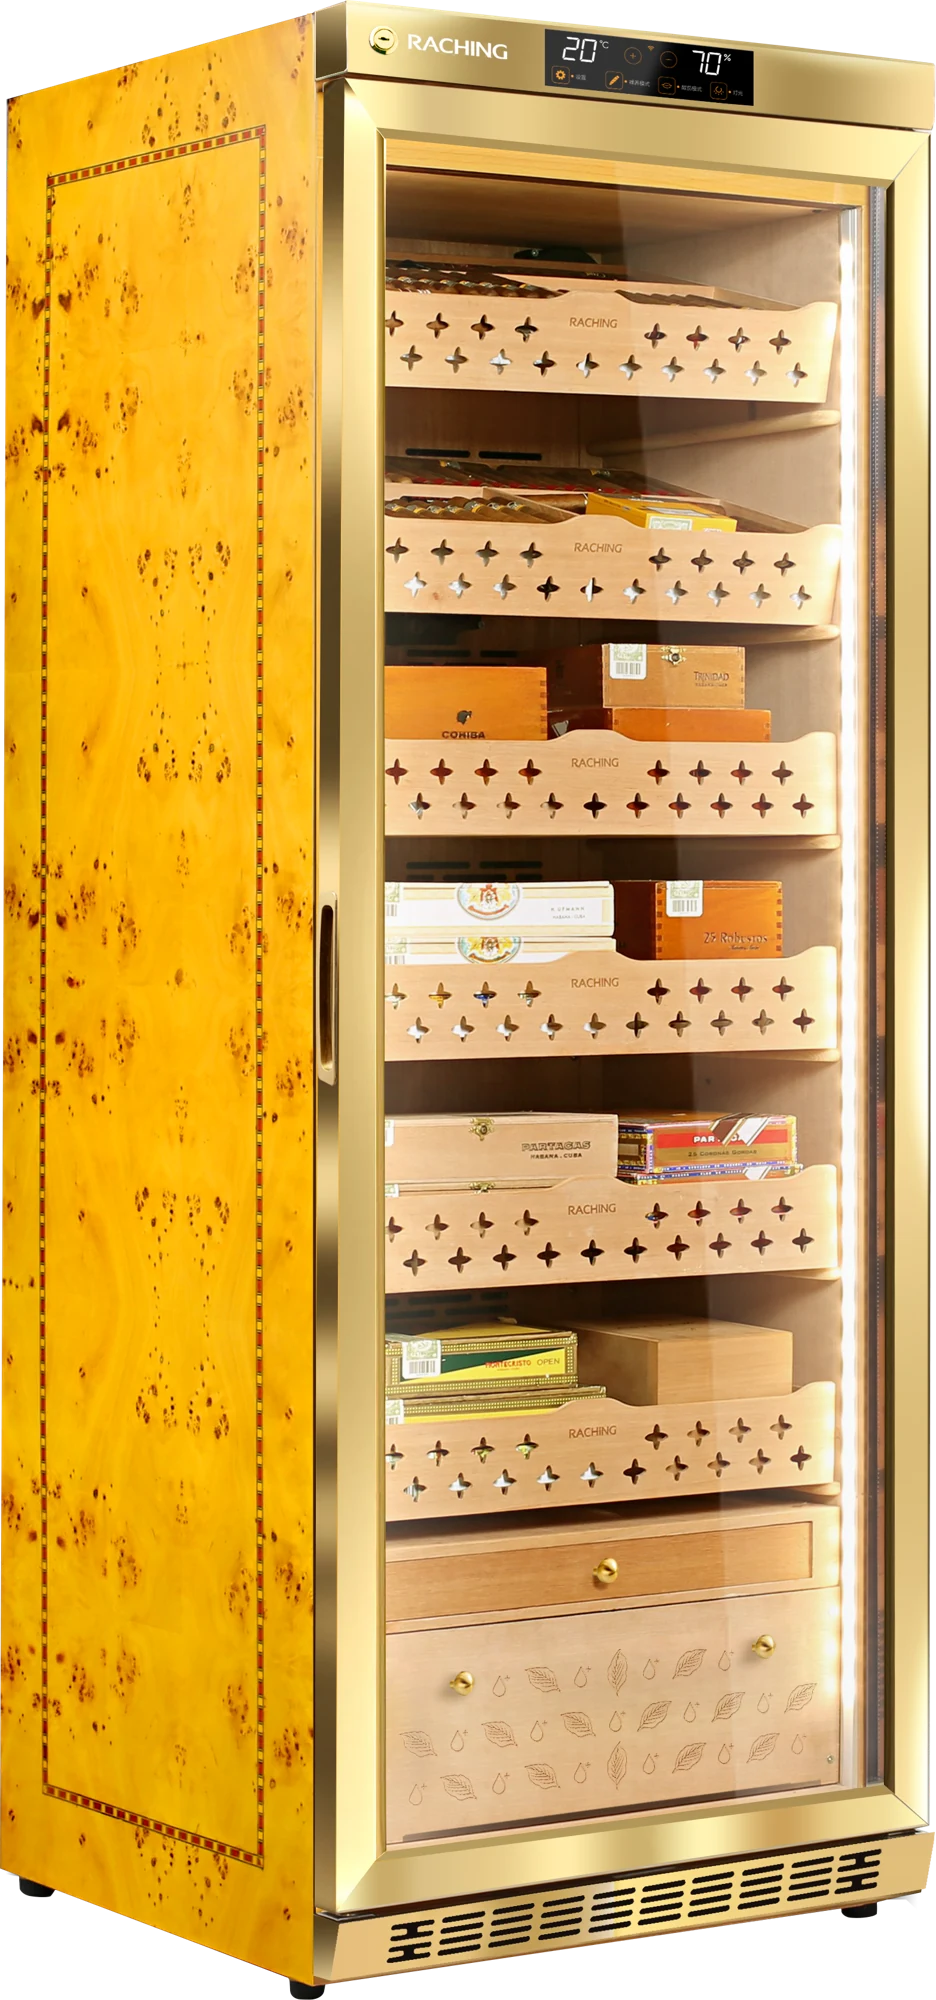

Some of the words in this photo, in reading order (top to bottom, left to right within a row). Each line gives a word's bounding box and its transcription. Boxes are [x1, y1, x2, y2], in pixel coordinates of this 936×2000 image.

[407, 33, 508, 60] RACHING
[569, 317, 618, 328] RACHING
[574, 542, 623, 553] RACHING
[693, 671, 730, 681] TRINIDAD
[441, 730, 486, 739] COHIBA
[571, 757, 619, 768] RACHING
[704, 932, 717, 943] 25
[571, 977, 619, 988] RACHING
[568, 1203, 617, 1215] RACHING
[536, 1358, 561, 1366] OPEN
[568, 1425, 617, 1439] RACHING
